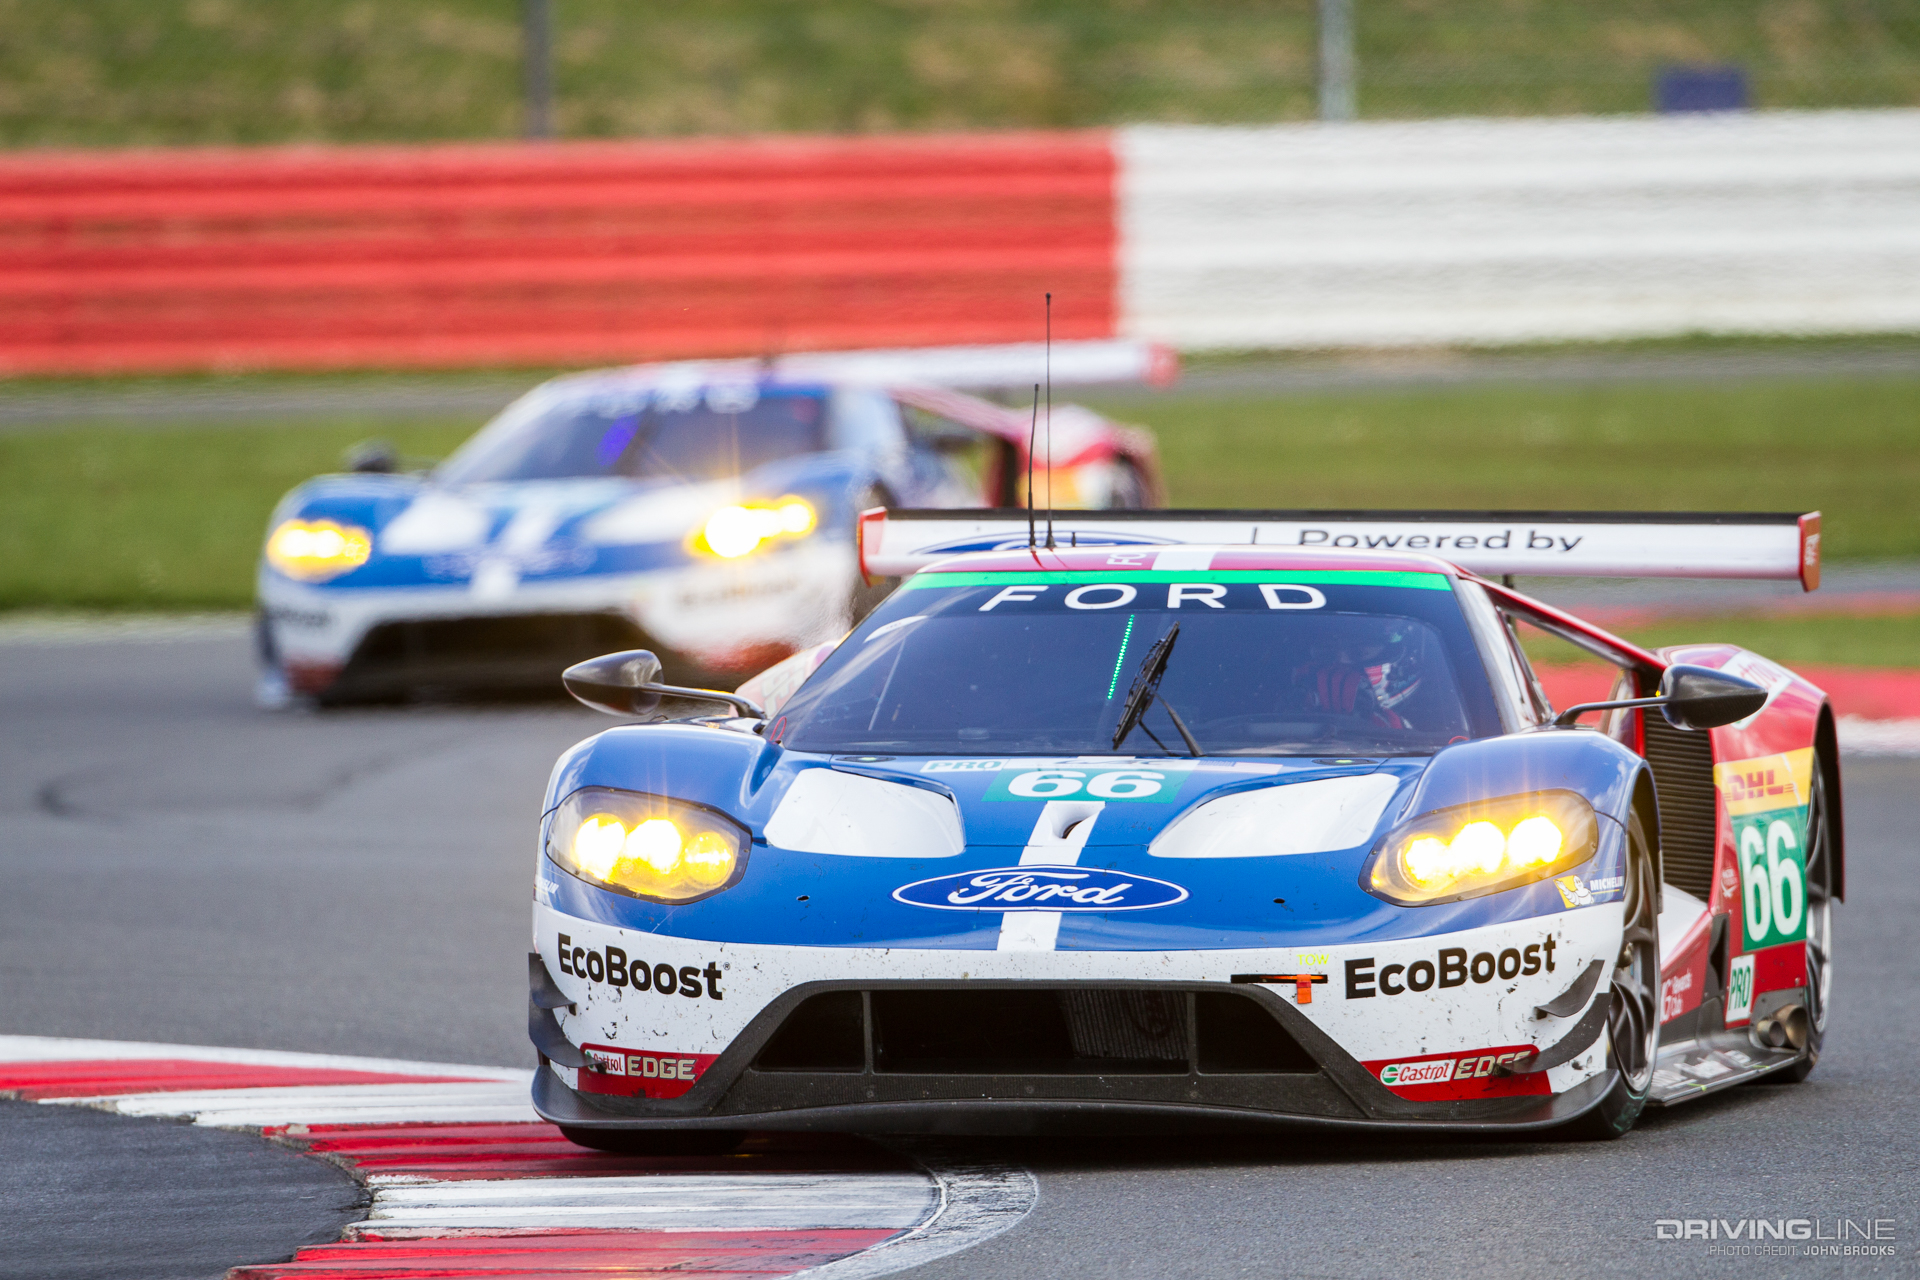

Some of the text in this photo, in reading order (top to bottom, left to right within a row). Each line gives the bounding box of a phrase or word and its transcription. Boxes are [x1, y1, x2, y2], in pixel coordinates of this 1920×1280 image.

[1299, 529, 1583, 552] Powered by
[979, 583, 1327, 612] FORD
[927, 761, 1002, 770] PRO
[1008, 770, 1165, 799] 66
[1726, 769, 1785, 801] DHL
[947, 871, 1133, 905] Ford
[1741, 819, 1804, 942] 66
[1296, 953, 1330, 966] TOW
[1728, 964, 1751, 1011] PRO
[626, 1054, 698, 1081] EDGE
[1399, 1062, 1450, 1083] Castrol
